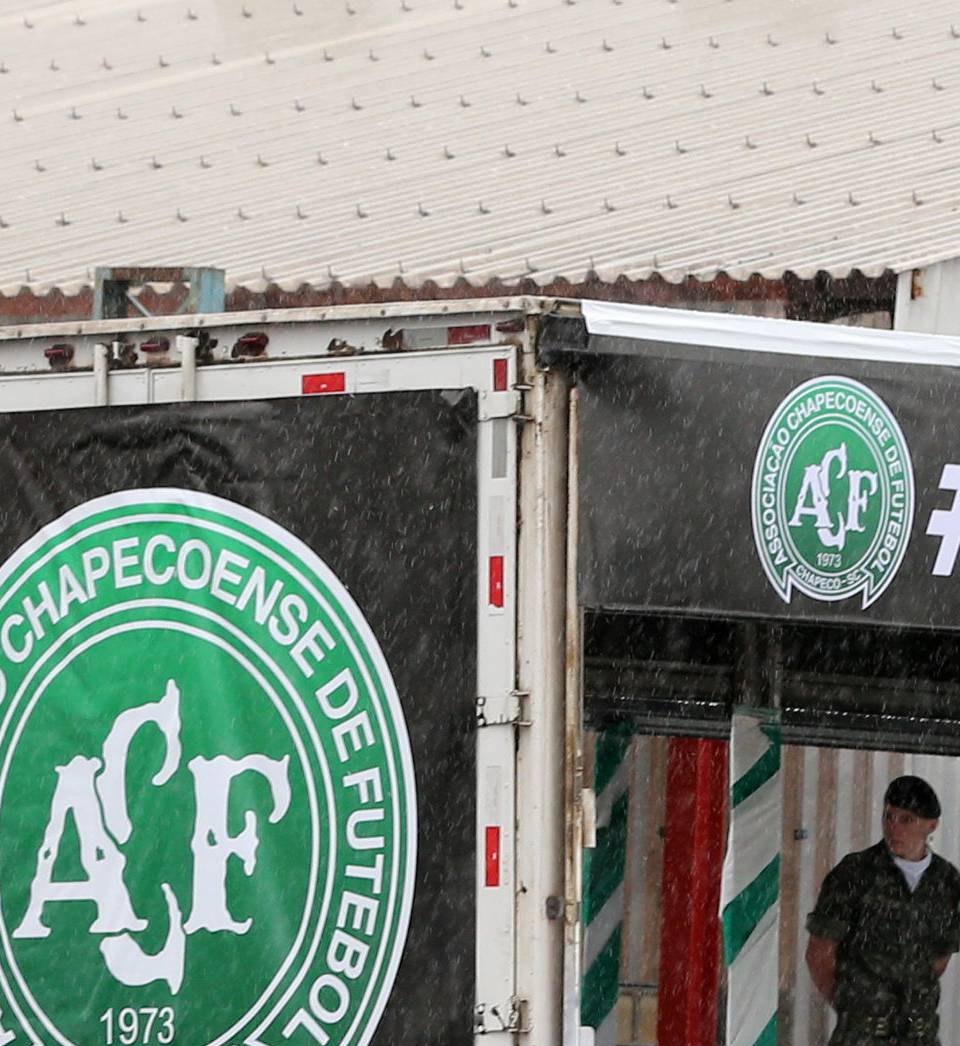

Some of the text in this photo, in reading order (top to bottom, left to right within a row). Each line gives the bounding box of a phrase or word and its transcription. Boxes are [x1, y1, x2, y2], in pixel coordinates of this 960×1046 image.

[786, 391, 891, 448] CHAPECOENSE
[885, 445, 902, 477] DE
[816, 552, 843, 569] 1973
[861, 479, 905, 574] FUTEBOL
[0, 533, 337, 679] CHAPECOENSE
[315, 667, 376, 763] DE
[282, 766, 385, 1046] FUTEBOL
[98, 1006, 176, 1046] 1973
